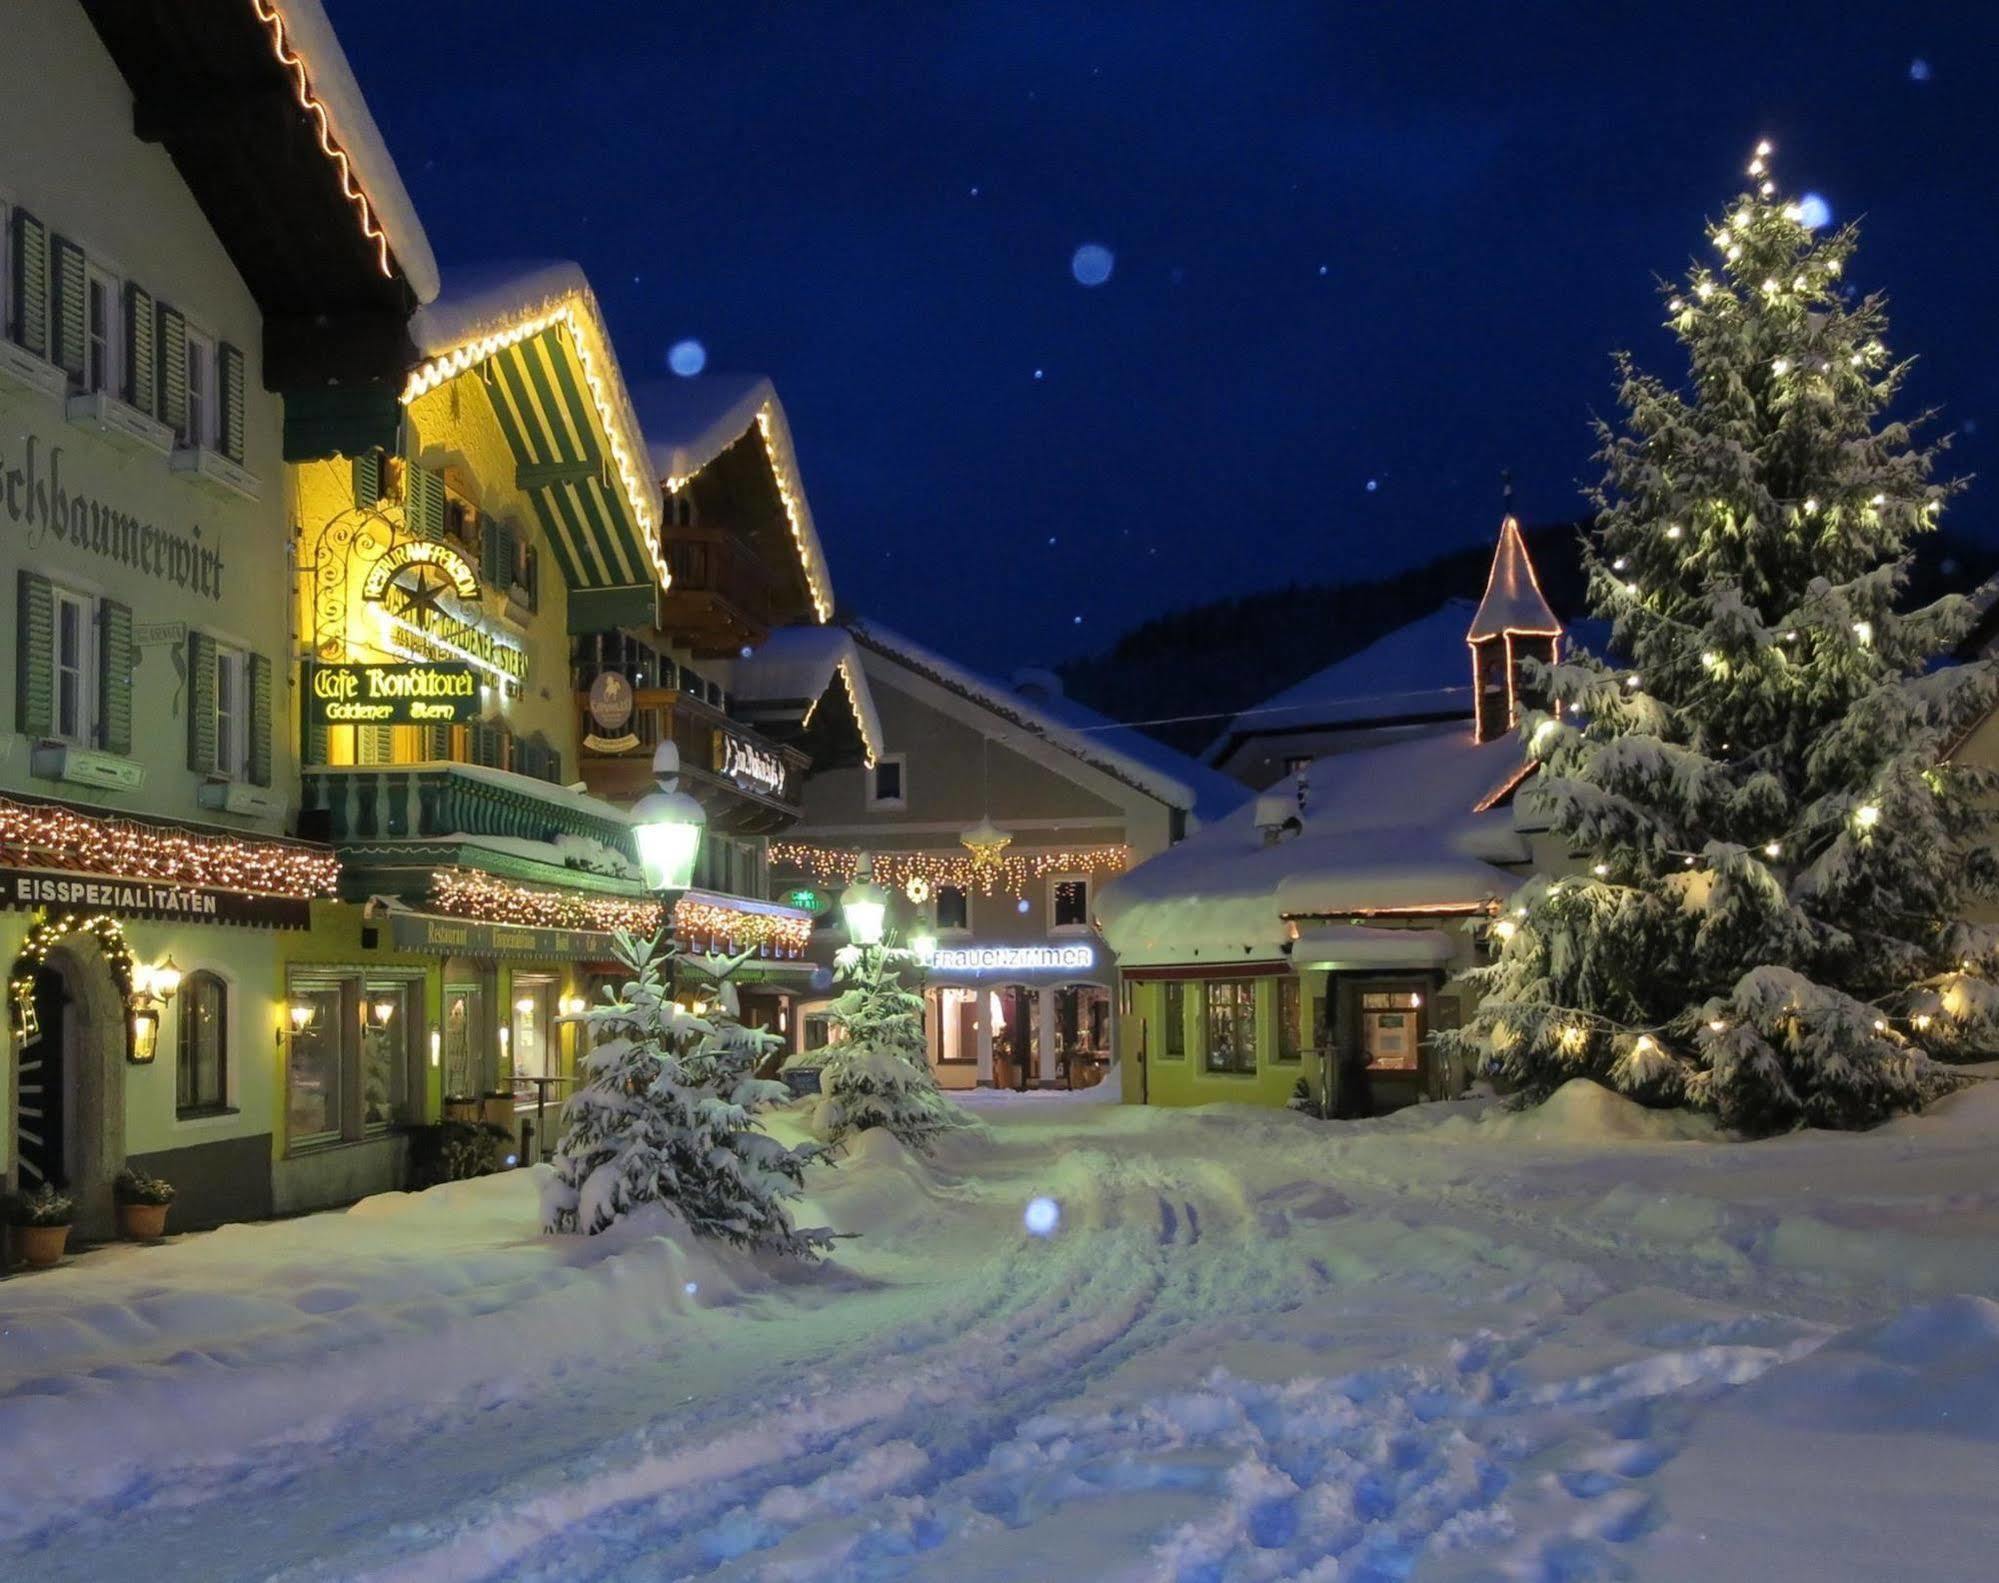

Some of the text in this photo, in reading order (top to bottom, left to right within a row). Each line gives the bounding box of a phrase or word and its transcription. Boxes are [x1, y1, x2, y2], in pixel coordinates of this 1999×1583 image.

[0, 435, 224, 602] chbaumerwirt
[326, 701, 455, 720] Goldener Stern
[17, 878, 217, 913] EISSPEZIALITÄTEN
